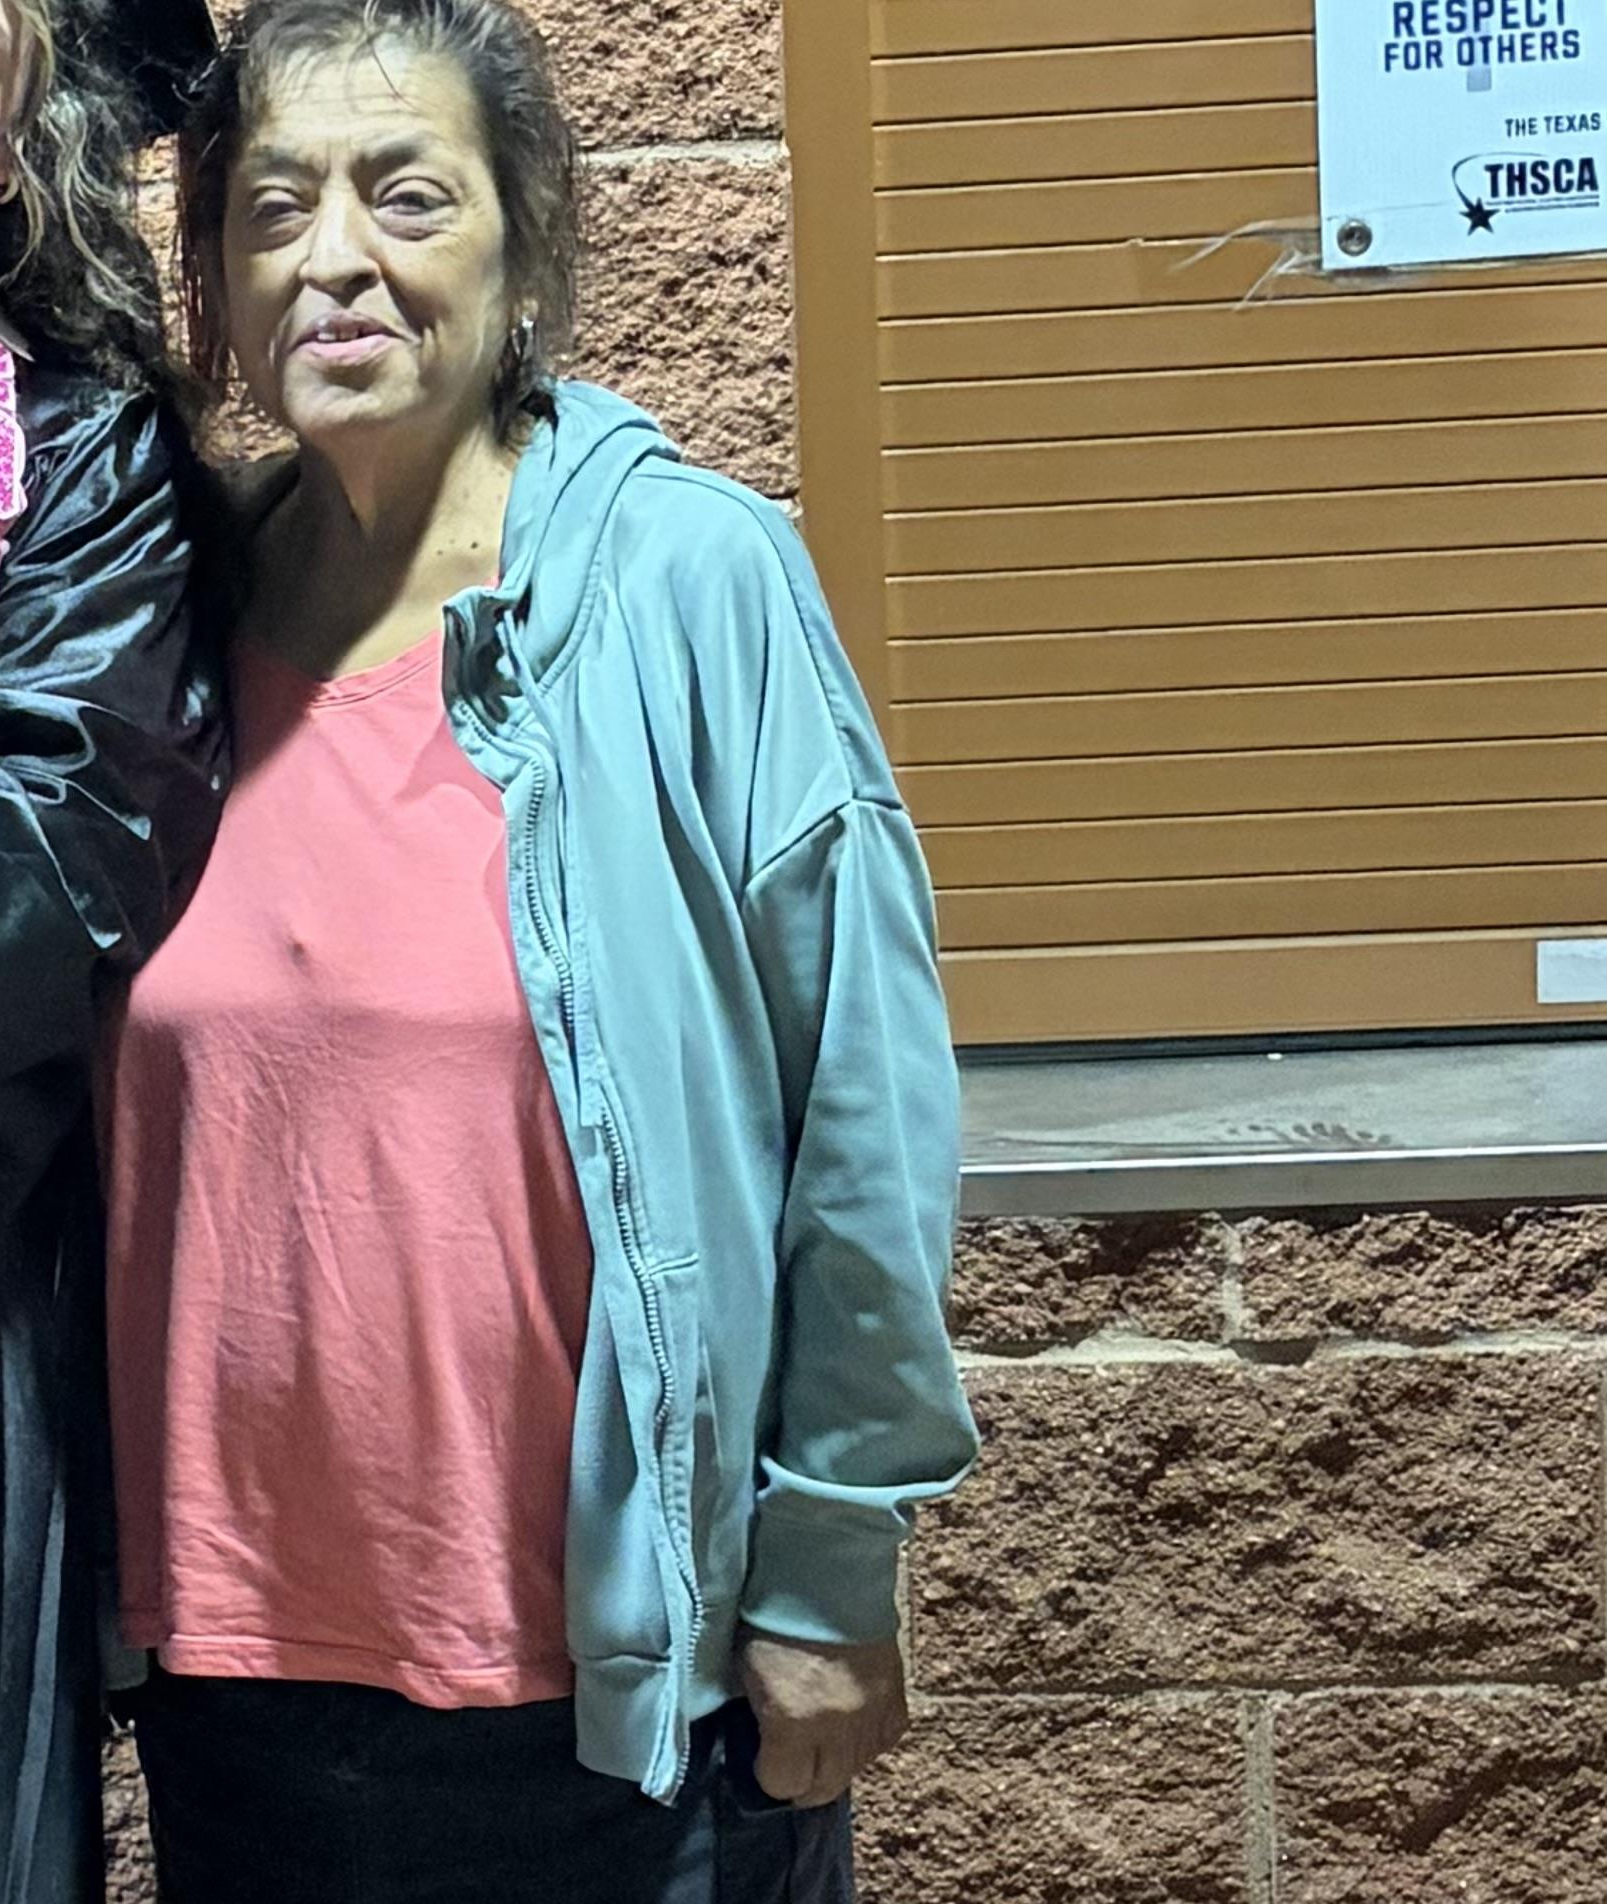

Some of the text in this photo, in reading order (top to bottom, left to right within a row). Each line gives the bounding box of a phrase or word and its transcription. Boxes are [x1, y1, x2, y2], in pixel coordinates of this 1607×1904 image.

[1383, 29, 1580, 73] FOR OTHERS
[1505, 112, 1601, 138] THE TEXAS
[1484, 157, 1599, 199] THSCA
